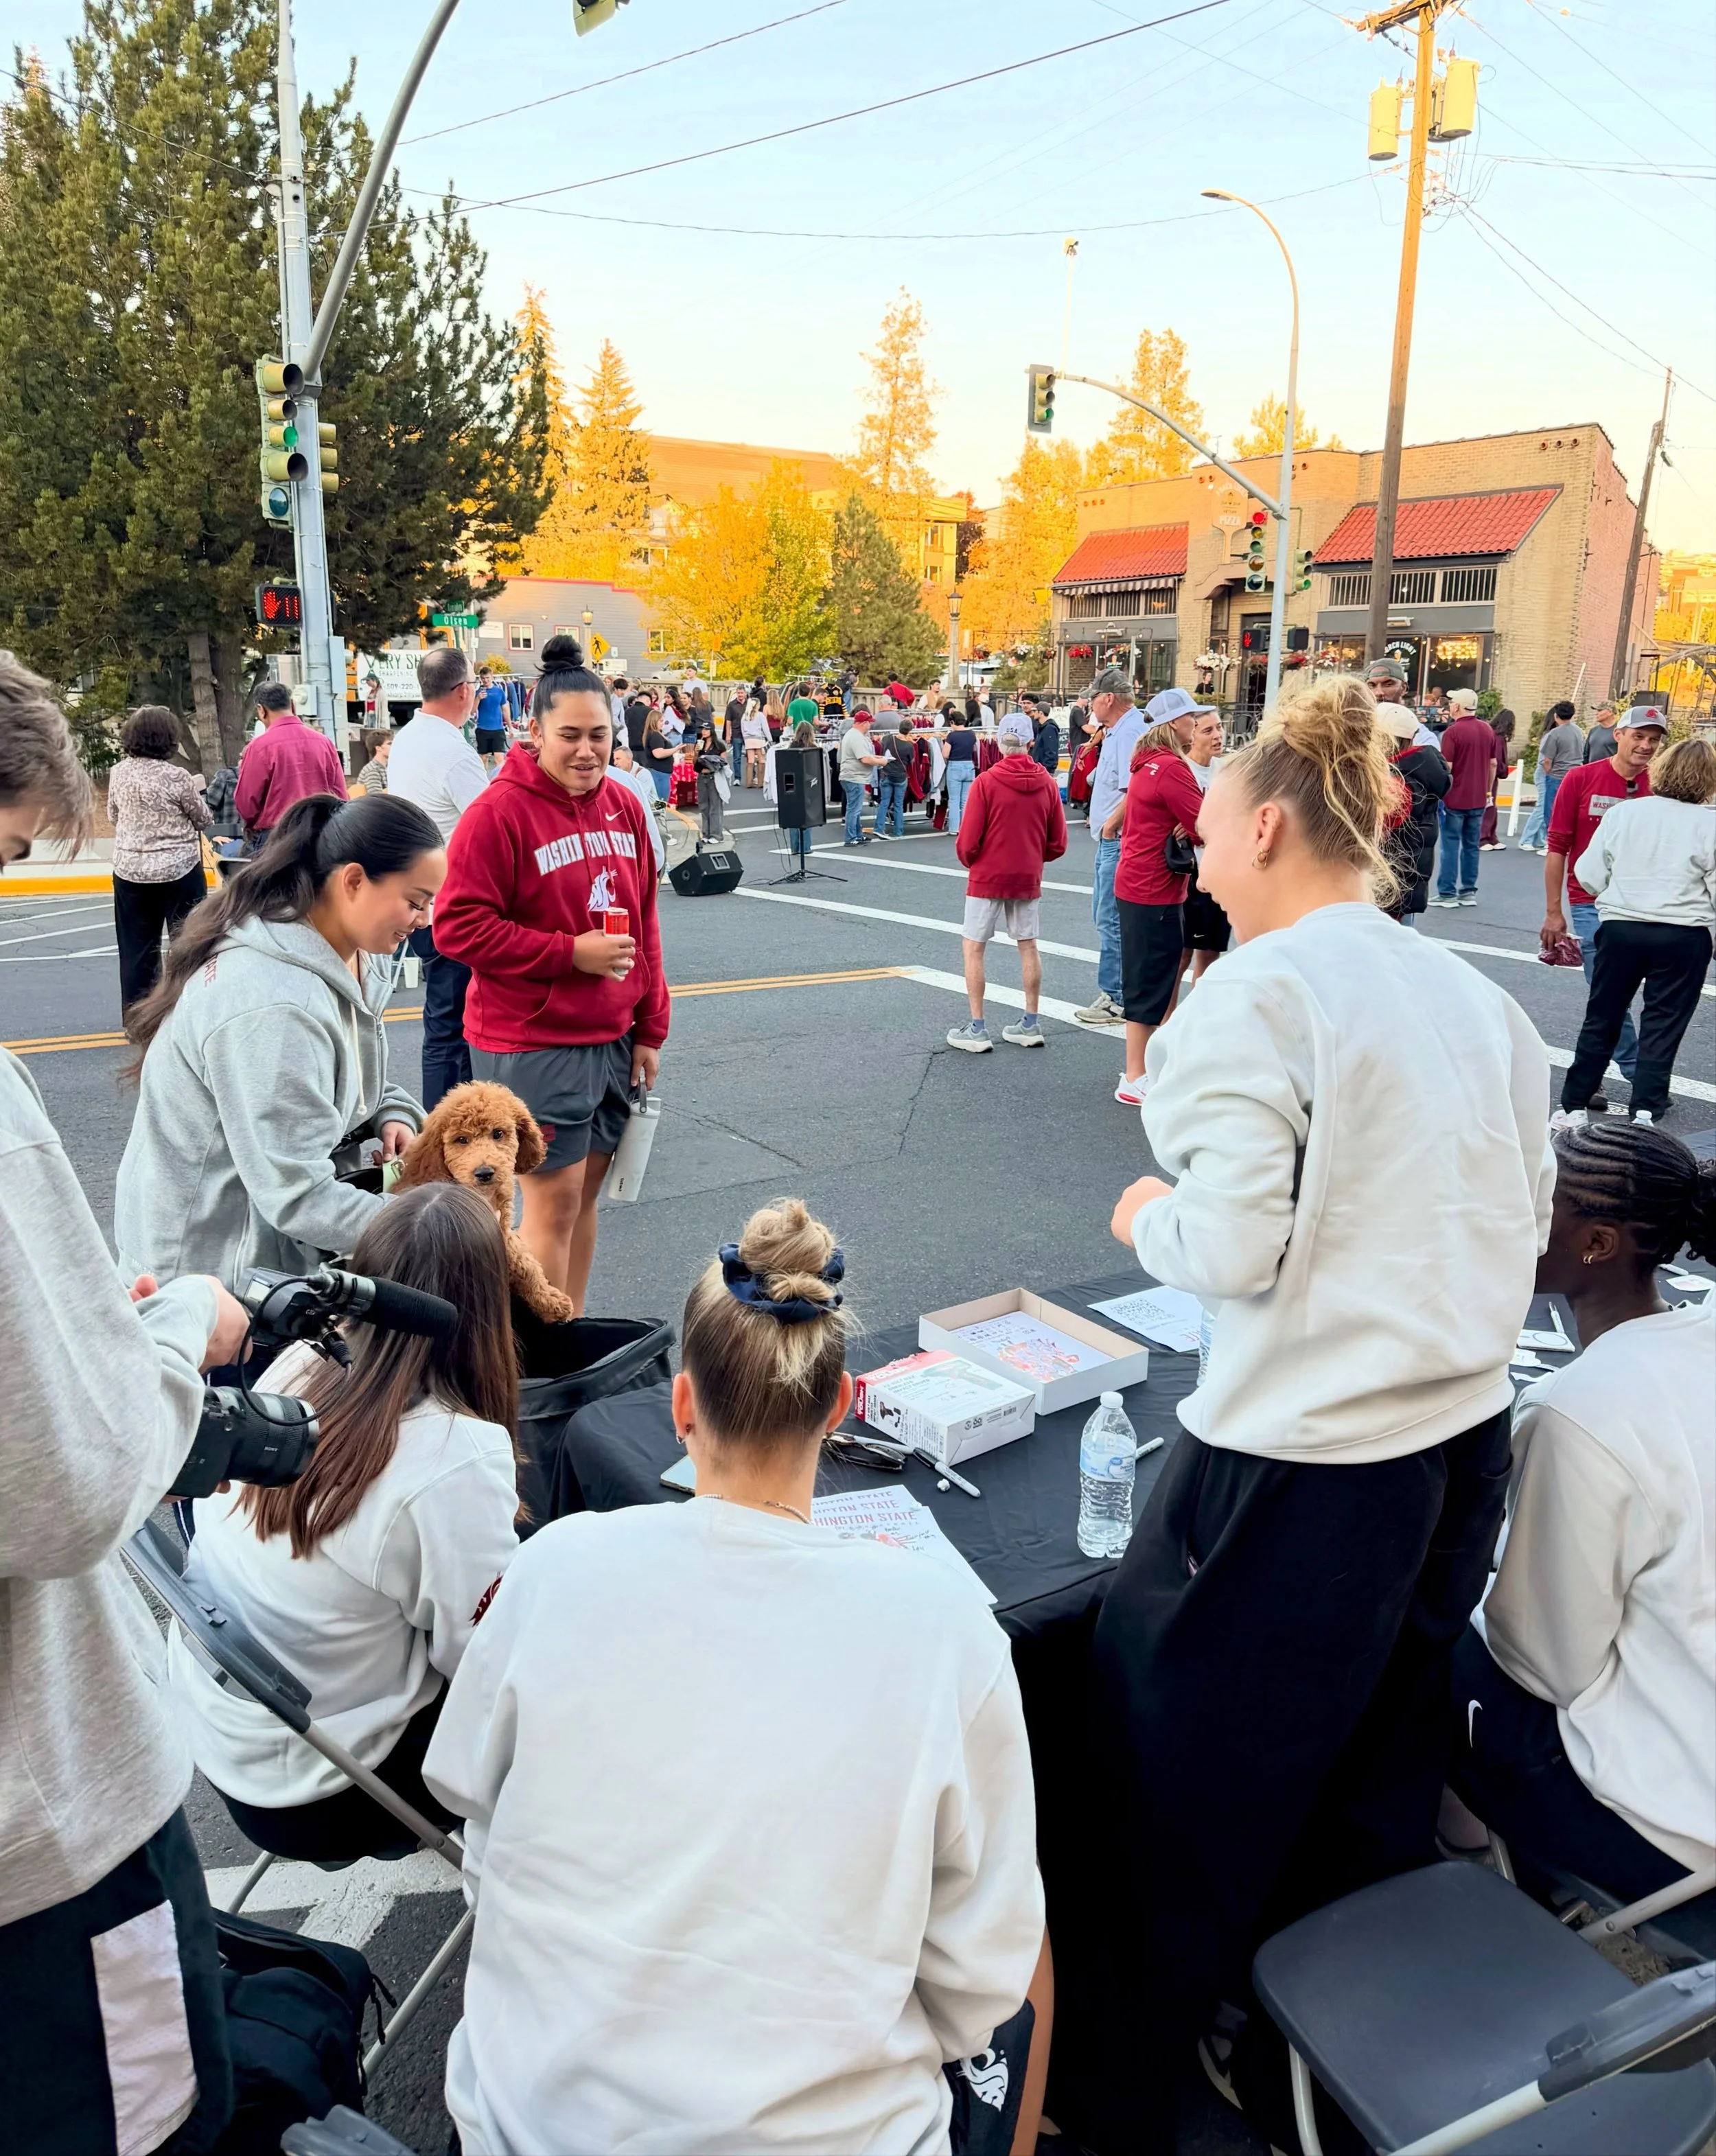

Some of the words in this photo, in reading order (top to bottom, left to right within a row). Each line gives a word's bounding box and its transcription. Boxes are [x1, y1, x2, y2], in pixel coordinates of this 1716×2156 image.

[285, 596, 299, 618] 11
[443, 616, 468, 625] Olsen
[533, 831, 612, 877] WASHINTON
[860, 1500, 899, 1510] STATE
[811, 1514, 874, 1526] HINGTON
[877, 1511, 917, 1522] STATE
